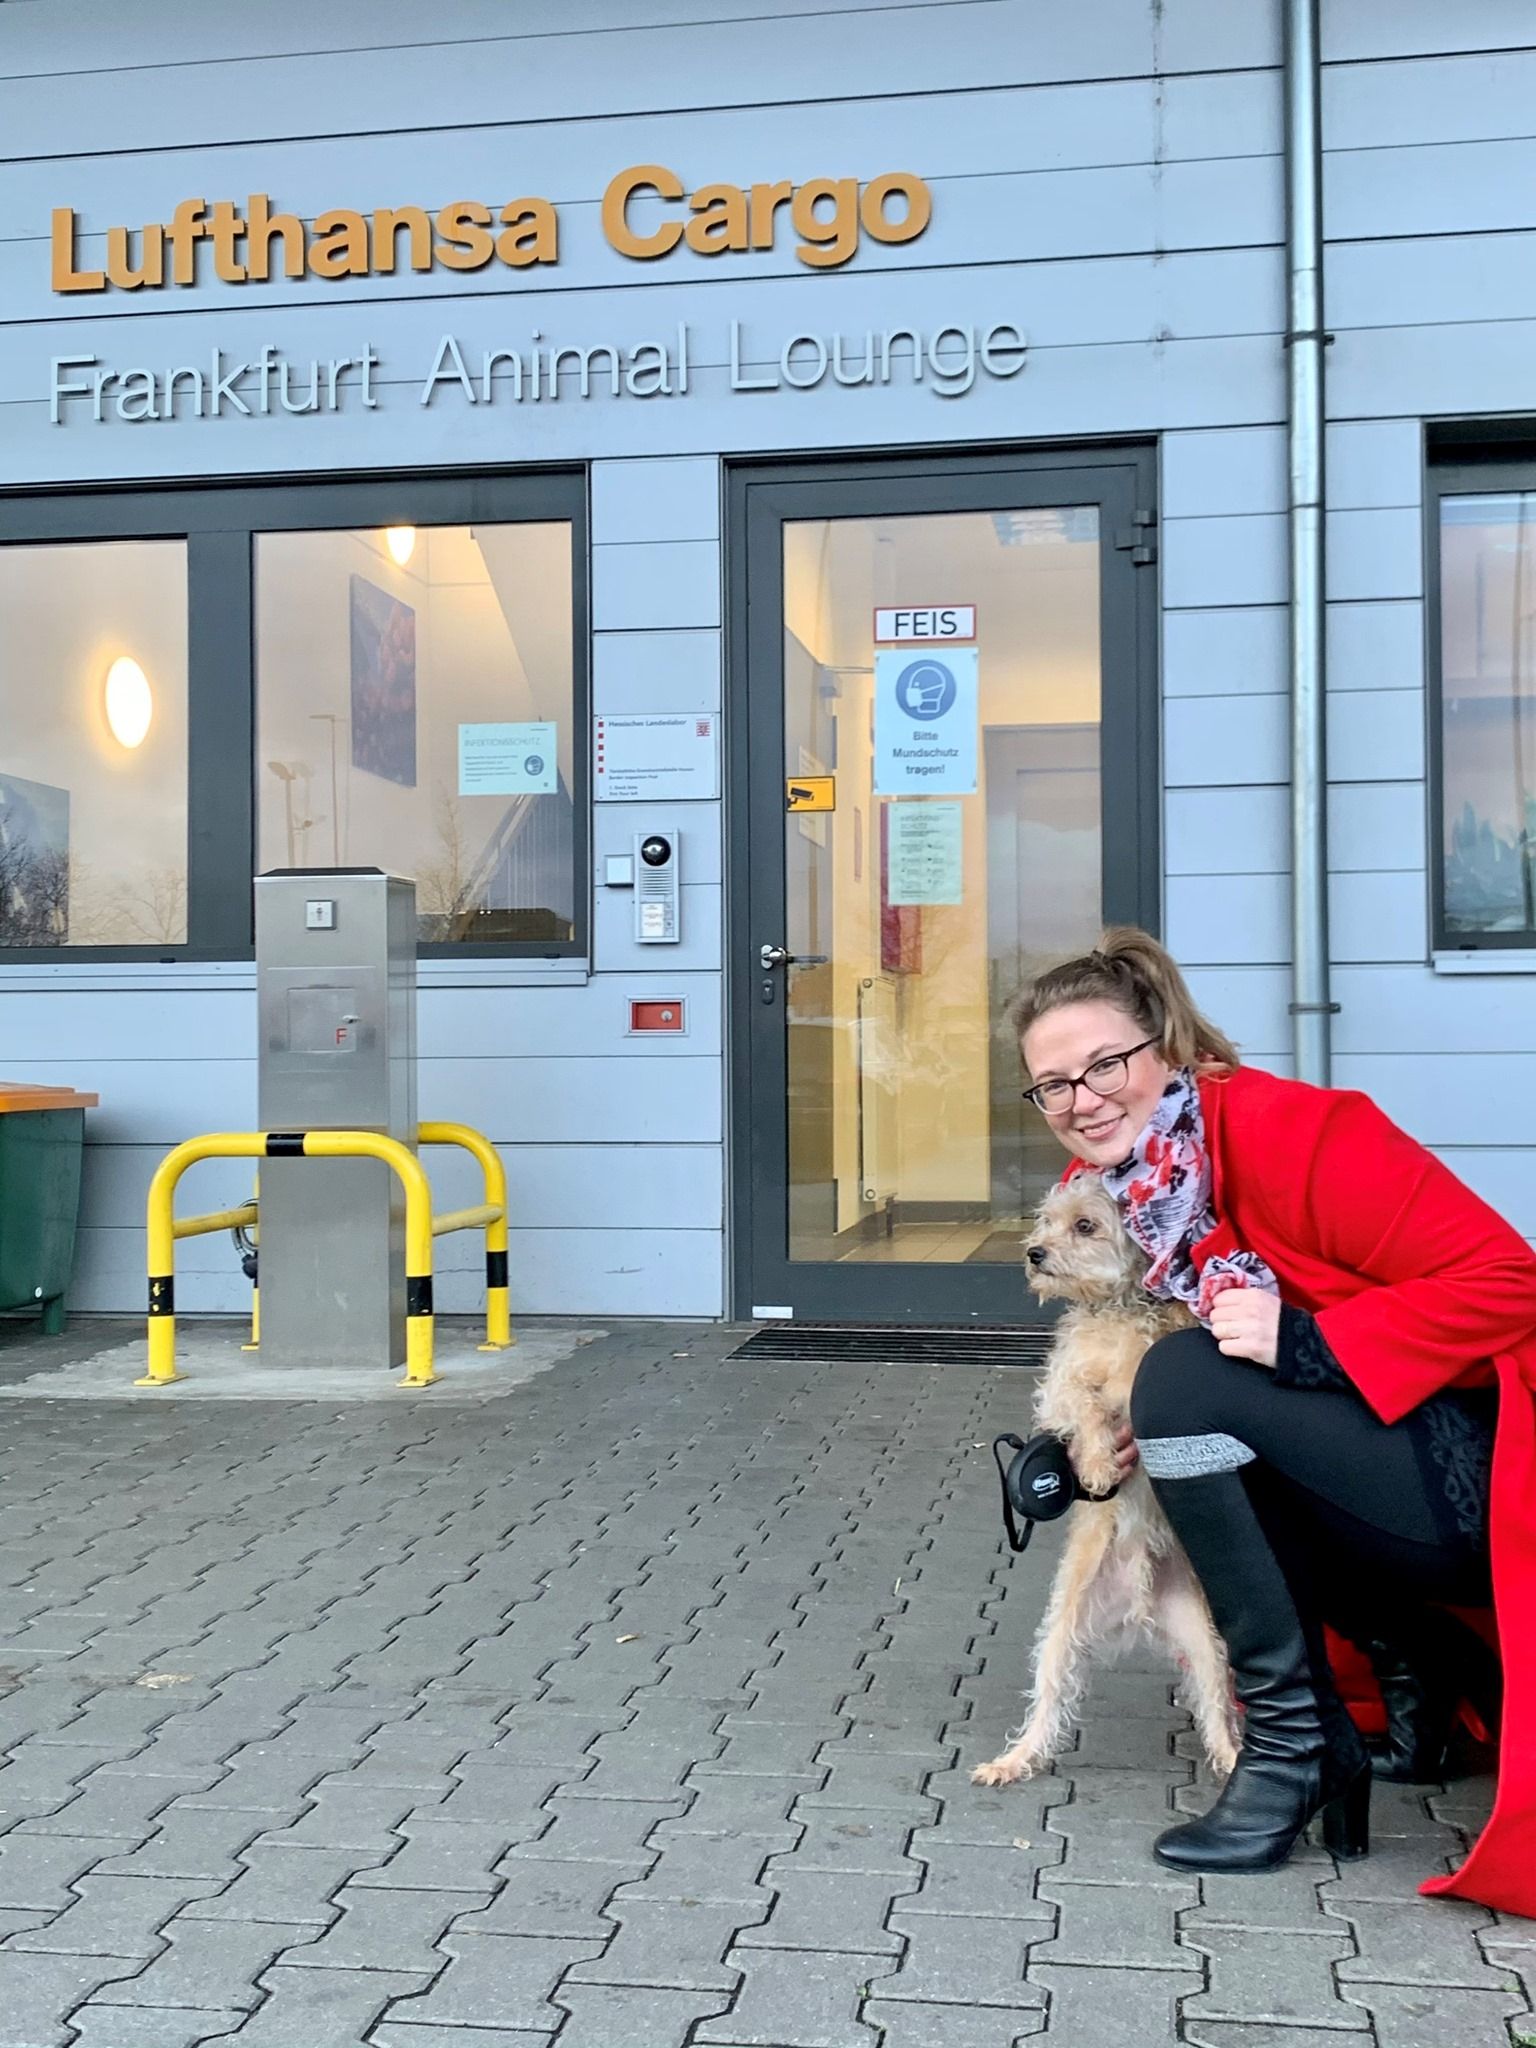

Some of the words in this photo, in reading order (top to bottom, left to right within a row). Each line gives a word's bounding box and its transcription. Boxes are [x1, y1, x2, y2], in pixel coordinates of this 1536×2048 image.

[51, 194, 559, 293] Lufthansa
[602, 164, 932, 268] Cargo
[49, 342, 378, 424] Frankfurt
[419, 321, 688, 406] Animal
[730, 320, 1028, 399] Lounge
[895, 611, 957, 637] FEIS
[913, 731, 938, 741] Bitte
[892, 747, 960, 758] Mundschutz
[905, 764, 945, 776] tragen!
[336, 1028, 347, 1045] F
